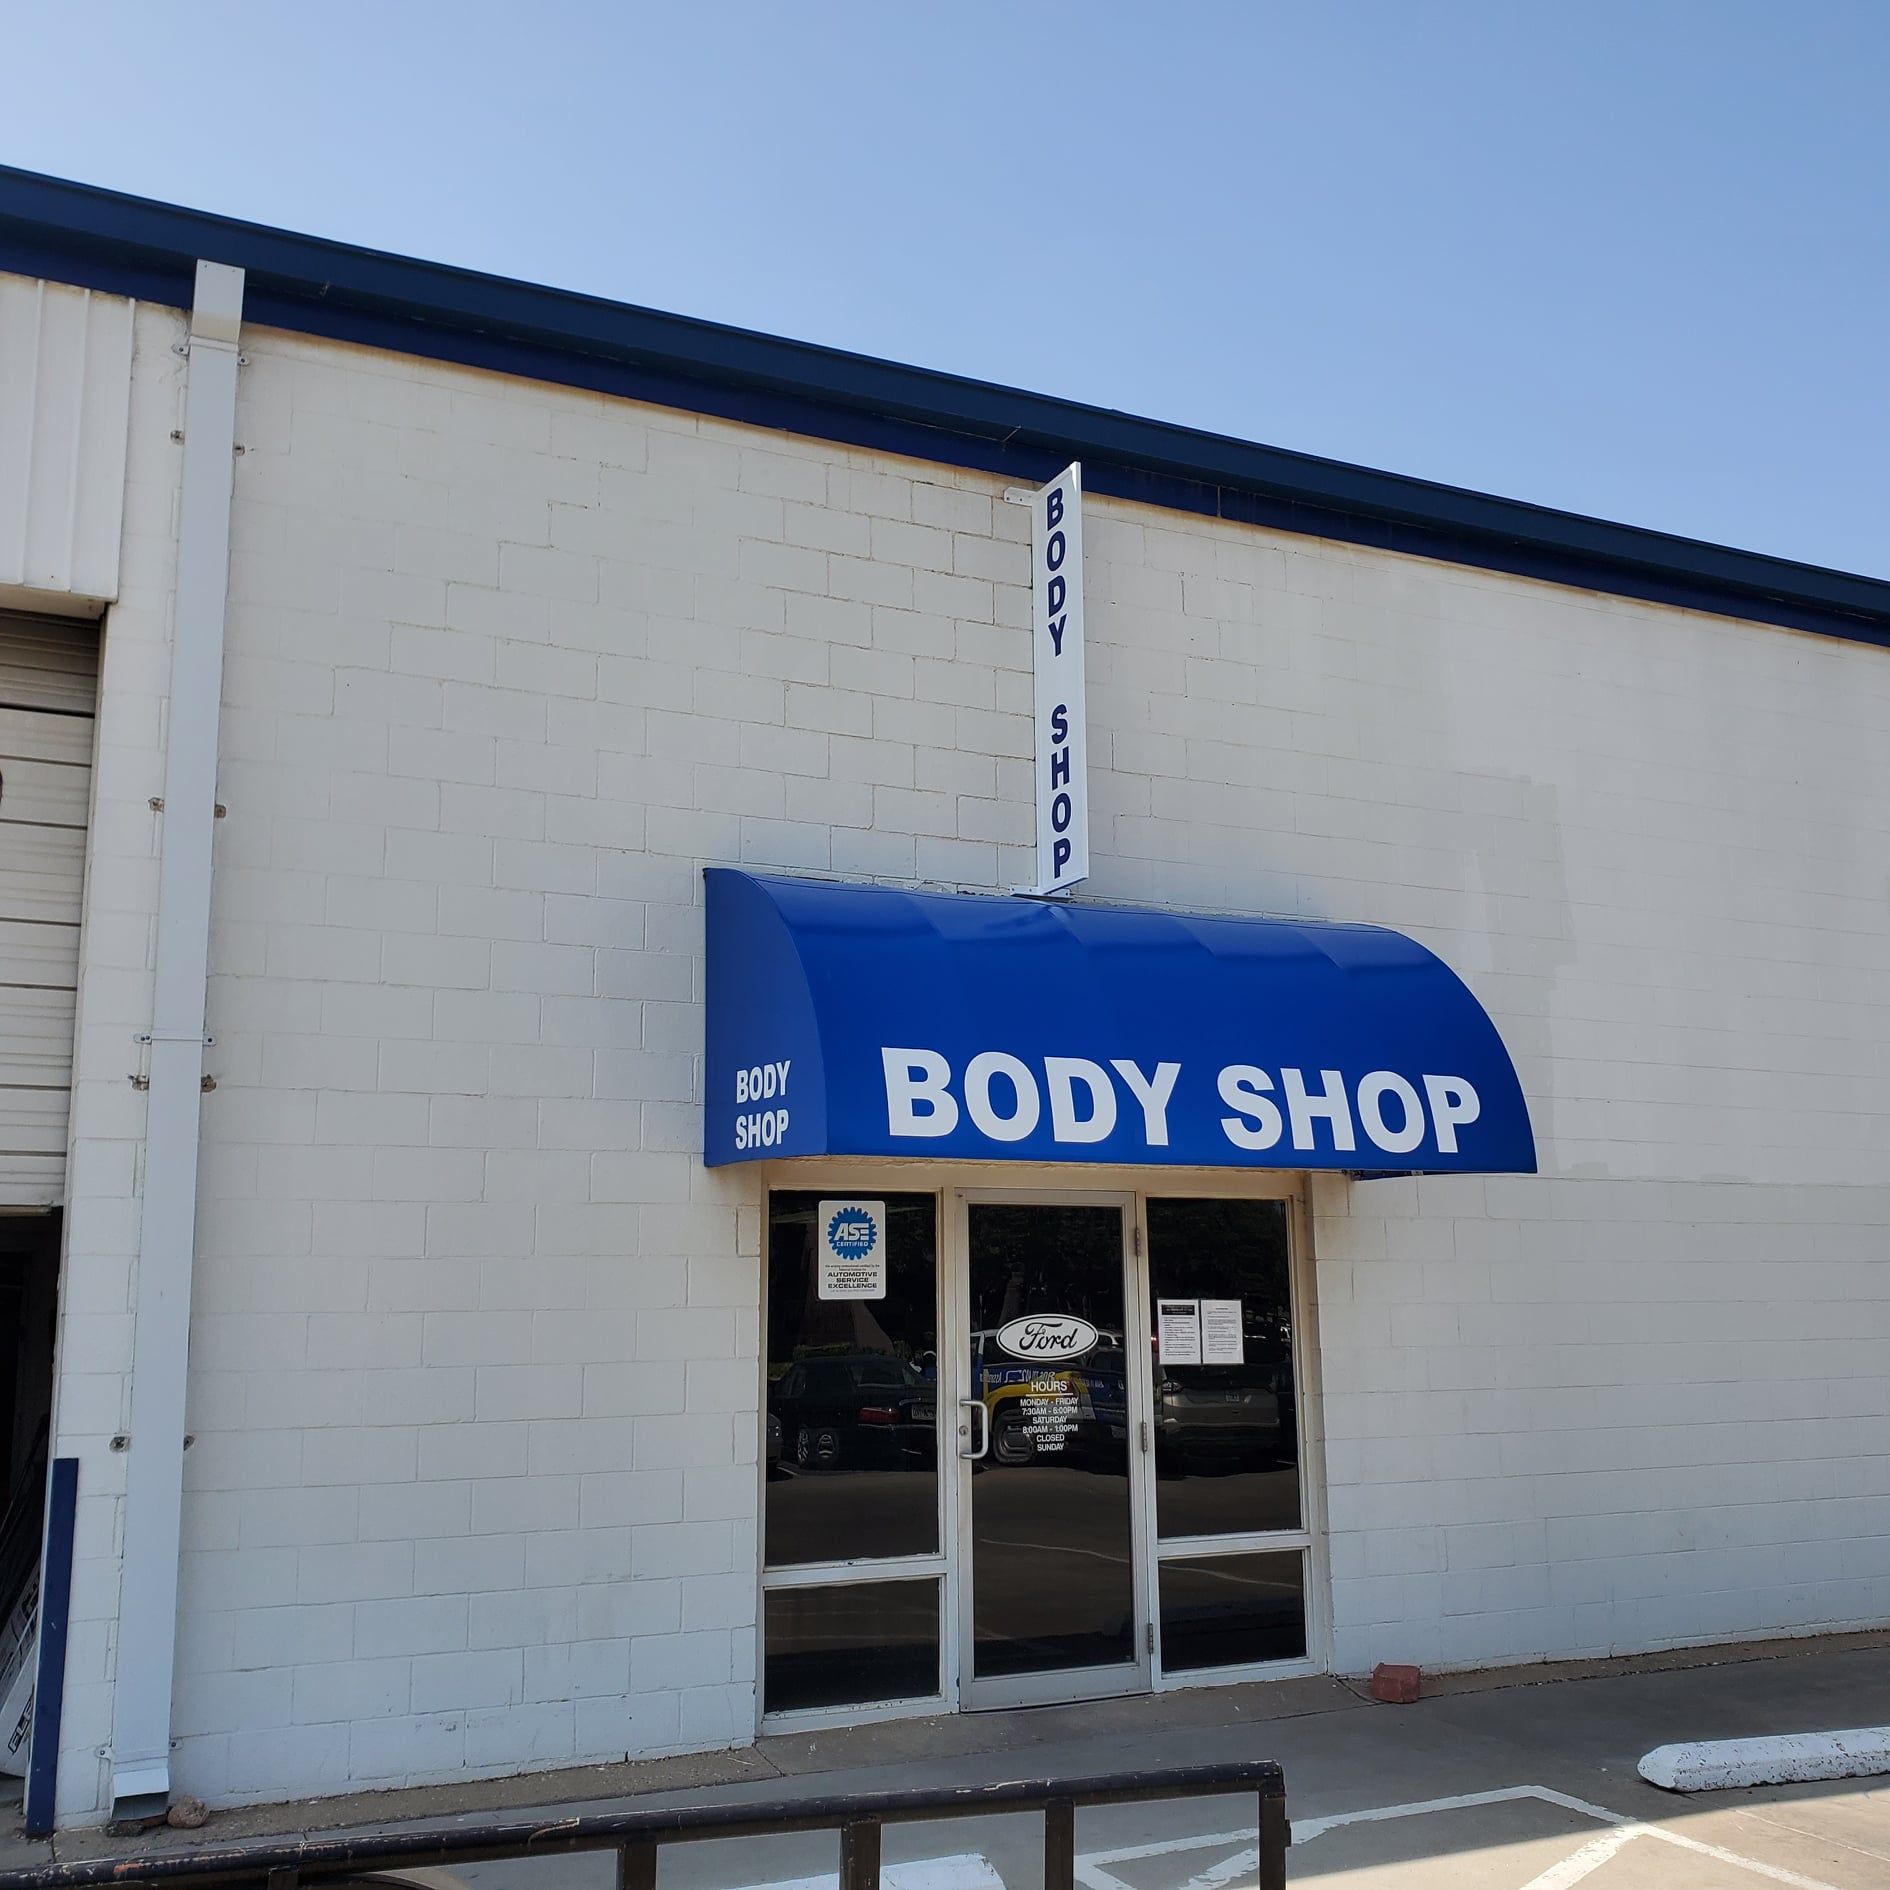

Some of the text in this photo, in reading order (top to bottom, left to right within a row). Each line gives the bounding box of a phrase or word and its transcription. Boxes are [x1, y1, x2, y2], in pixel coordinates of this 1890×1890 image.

[1046, 486, 1071, 879] BODY SHOP
[736, 1060, 791, 1104] BODY
[881, 1047, 1481, 1154] BODY SHOP
[735, 1109, 789, 1150] SHOP
[833, 1222, 870, 1241] ASE
[1019, 1322, 1079, 1351] Ford
[1031, 1381, 1068, 1392] HOURS
[1020, 1398, 1049, 1407] MONDAY
[1055, 1397, 1079, 1405] FRIDAY
[1021, 1407, 1047, 1416] 7:30AM
[1032, 1416, 1067, 1424] SATURDAY
[1022, 1425, 1048, 1434] 8:00AM
[1054, 1424, 1078, 1432] 1:00PM
[1036, 1434, 1064, 1442] CLOSED
[1037, 1443, 1064, 1451] SUNDAY
